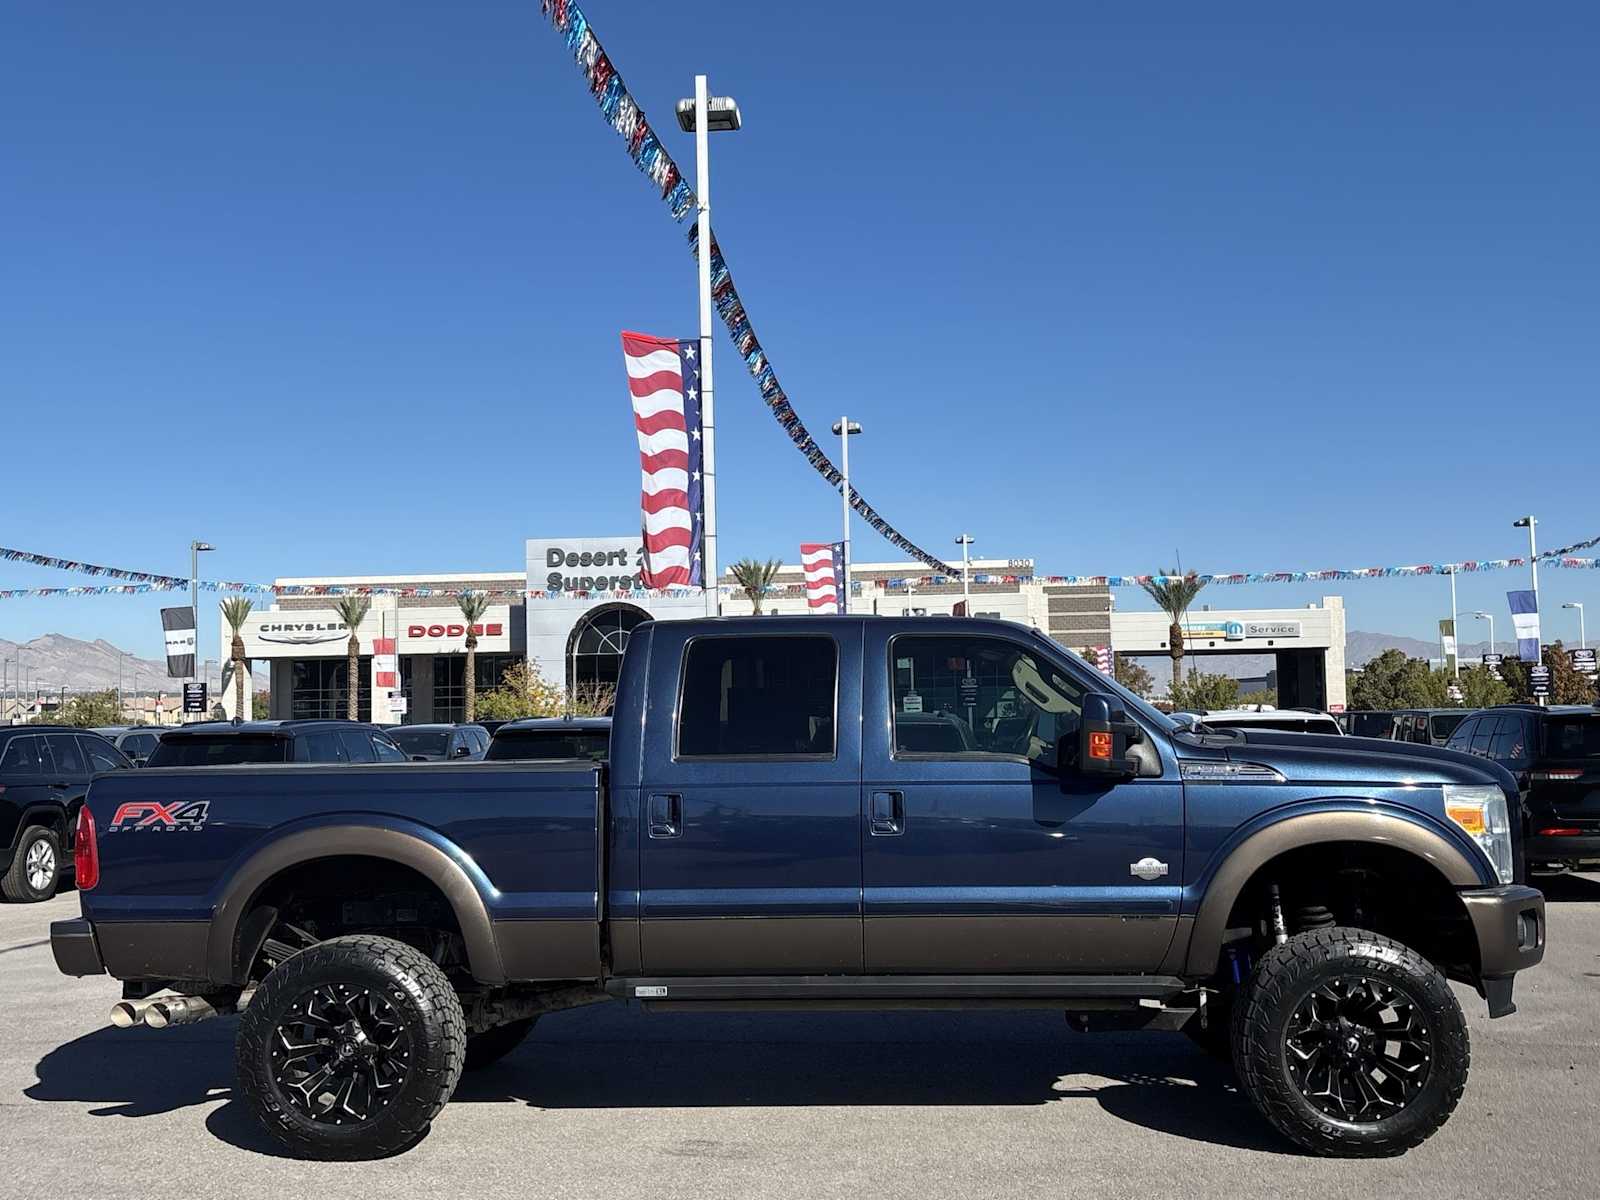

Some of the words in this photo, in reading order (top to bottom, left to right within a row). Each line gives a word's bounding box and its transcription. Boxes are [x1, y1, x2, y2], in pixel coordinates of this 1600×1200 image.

[547, 548, 627, 567] Desert
[260, 623, 348, 632] CHRYSLER
[1250, 625, 1295, 634] Service
[111, 800, 210, 826] FX4
